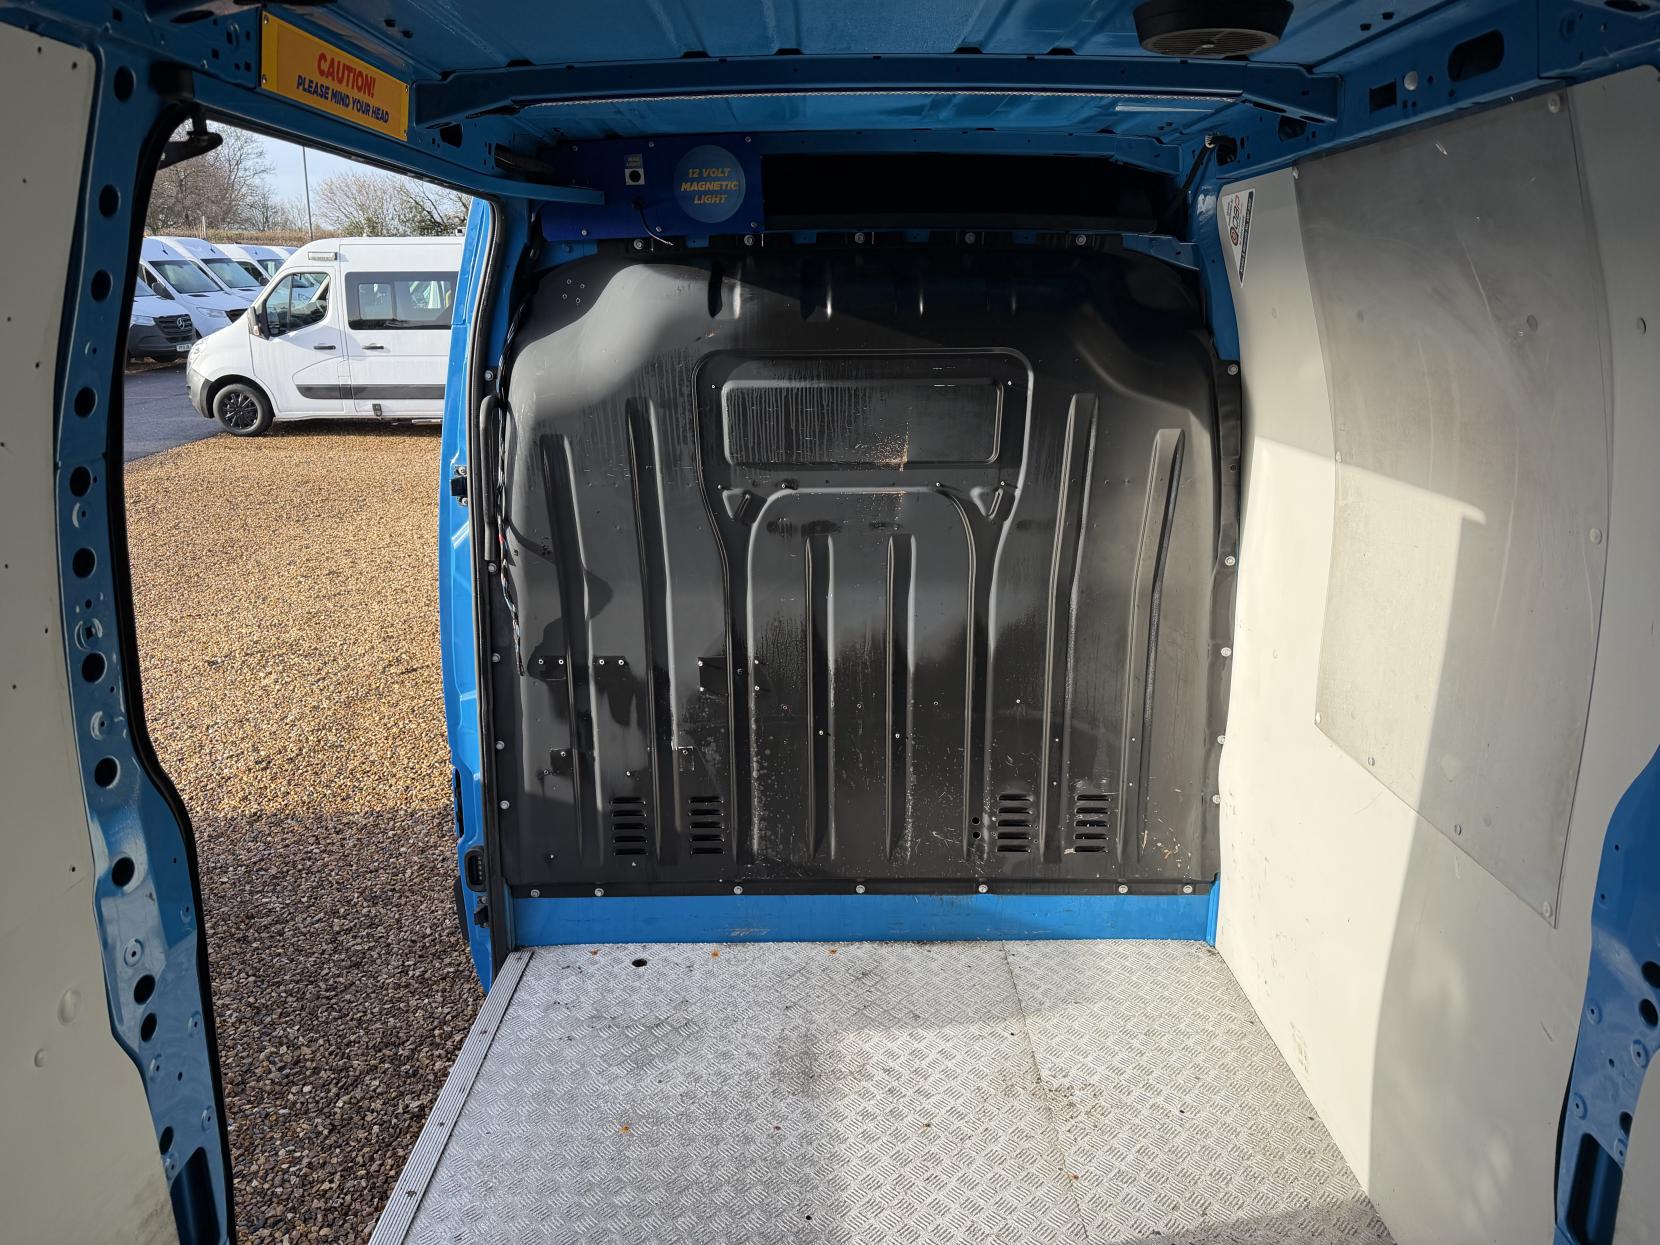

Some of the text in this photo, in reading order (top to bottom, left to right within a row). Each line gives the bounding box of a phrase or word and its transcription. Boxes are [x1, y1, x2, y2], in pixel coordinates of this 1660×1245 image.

[317, 52, 376, 97] CAUTION!
[296, 75, 389, 123] PLEASE MIND YOUR HEAD
[688, 167, 730, 178] 12 VOLT
[681, 180, 739, 192] MAGNETIC
[694, 194, 728, 204] LIGHT
